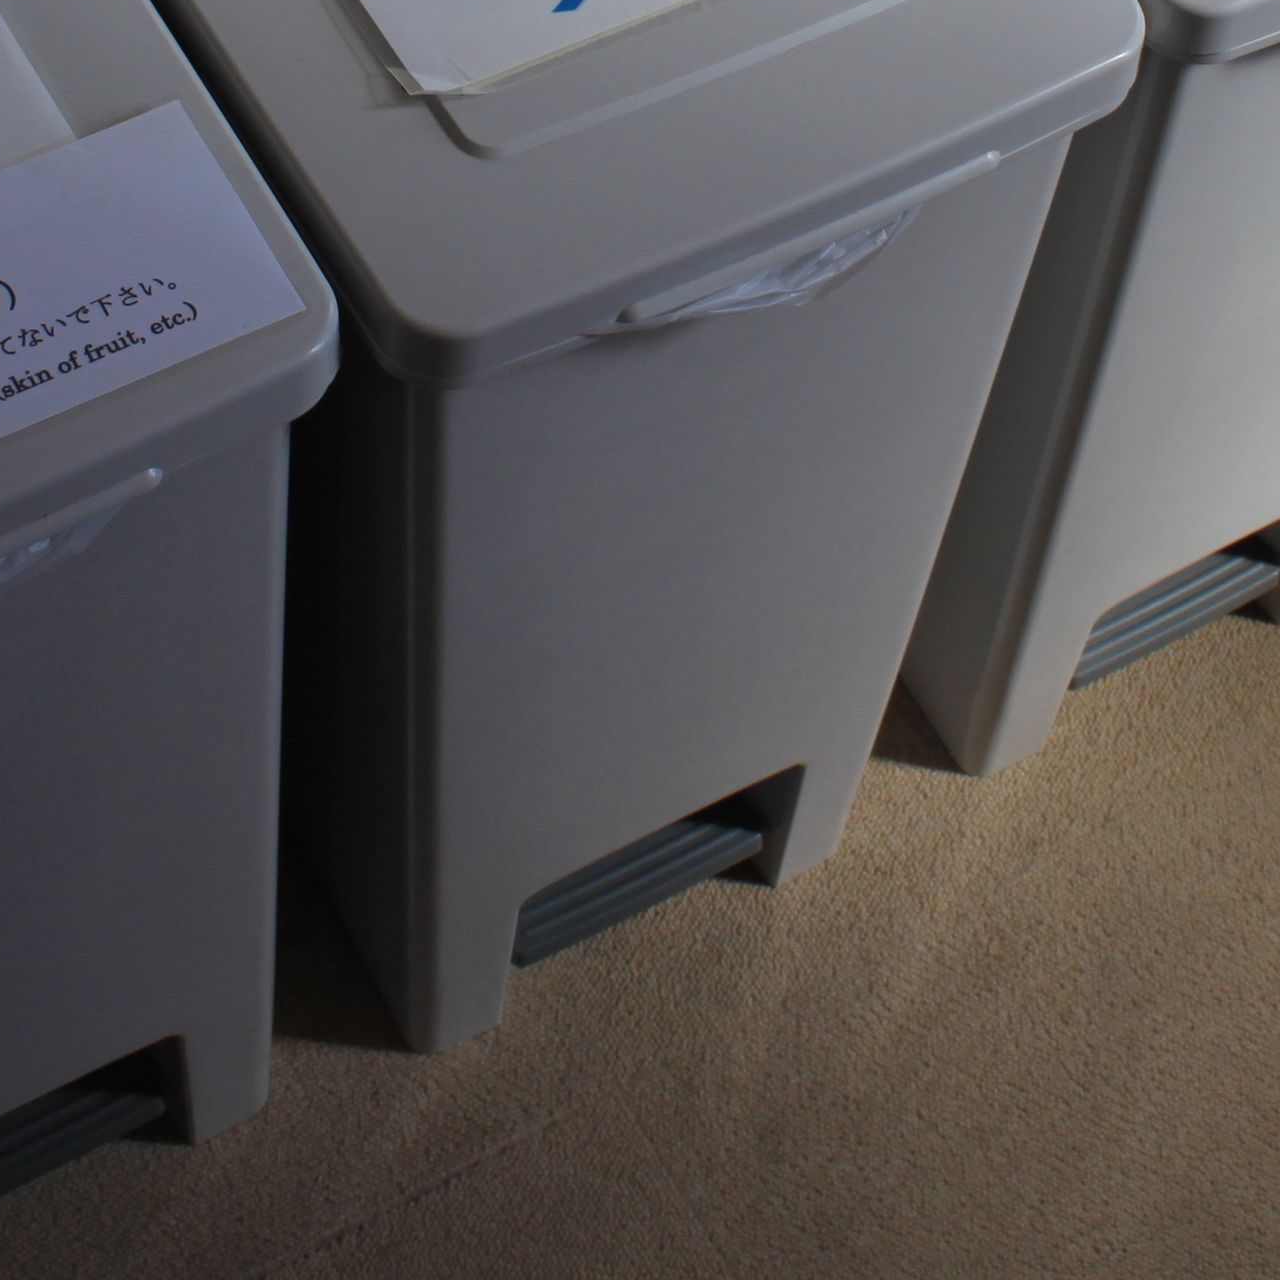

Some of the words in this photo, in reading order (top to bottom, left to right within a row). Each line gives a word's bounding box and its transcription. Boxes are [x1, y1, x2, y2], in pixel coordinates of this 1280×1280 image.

[58, 349, 85, 374] of
[83, 328, 147, 364] fruit,
[150, 301, 198, 335] etc.)
